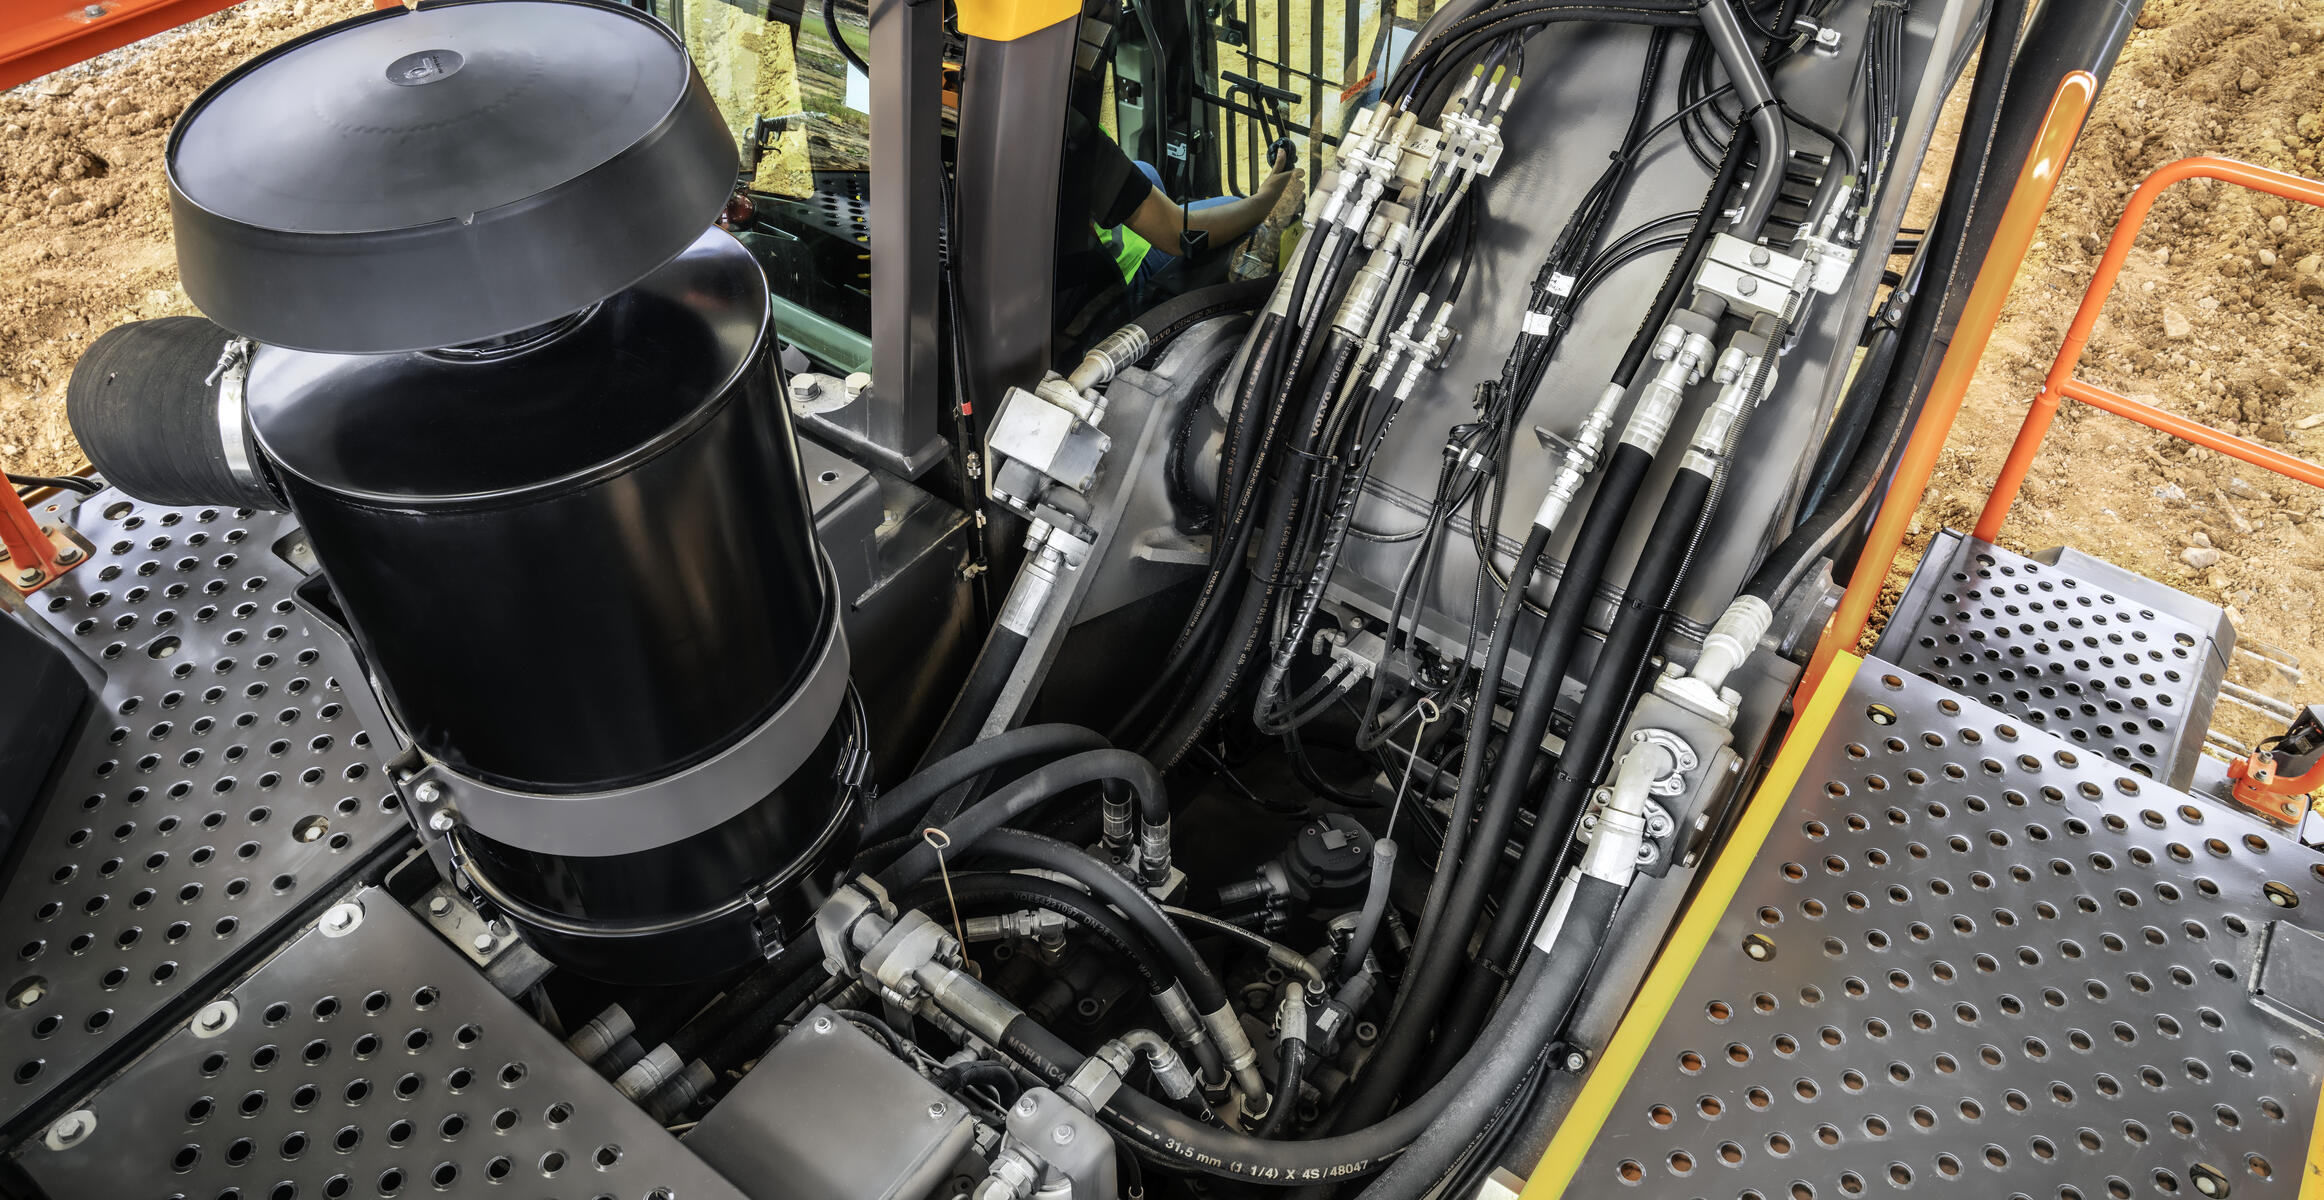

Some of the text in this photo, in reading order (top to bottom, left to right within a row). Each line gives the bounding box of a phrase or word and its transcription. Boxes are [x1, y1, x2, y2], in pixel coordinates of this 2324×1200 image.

[1308, 337, 1355, 439] VOLVO VOE54213
[1203, 568, 1221, 595] VOLVO
[1234, 651, 1248, 668] WP
[1081, 915, 1100, 929] DN
[1135, 961, 1154, 979] WP
[1007, 1035, 1042, 1067] MSHA
[1165, 1138, 1194, 1158] 31,5
[1196, 1152, 1222, 1168] mm
[1230, 1161, 1243, 1173] (1
[1251, 1165, 1279, 1179] 1/4)
[1285, 1169, 1295, 1180] X
